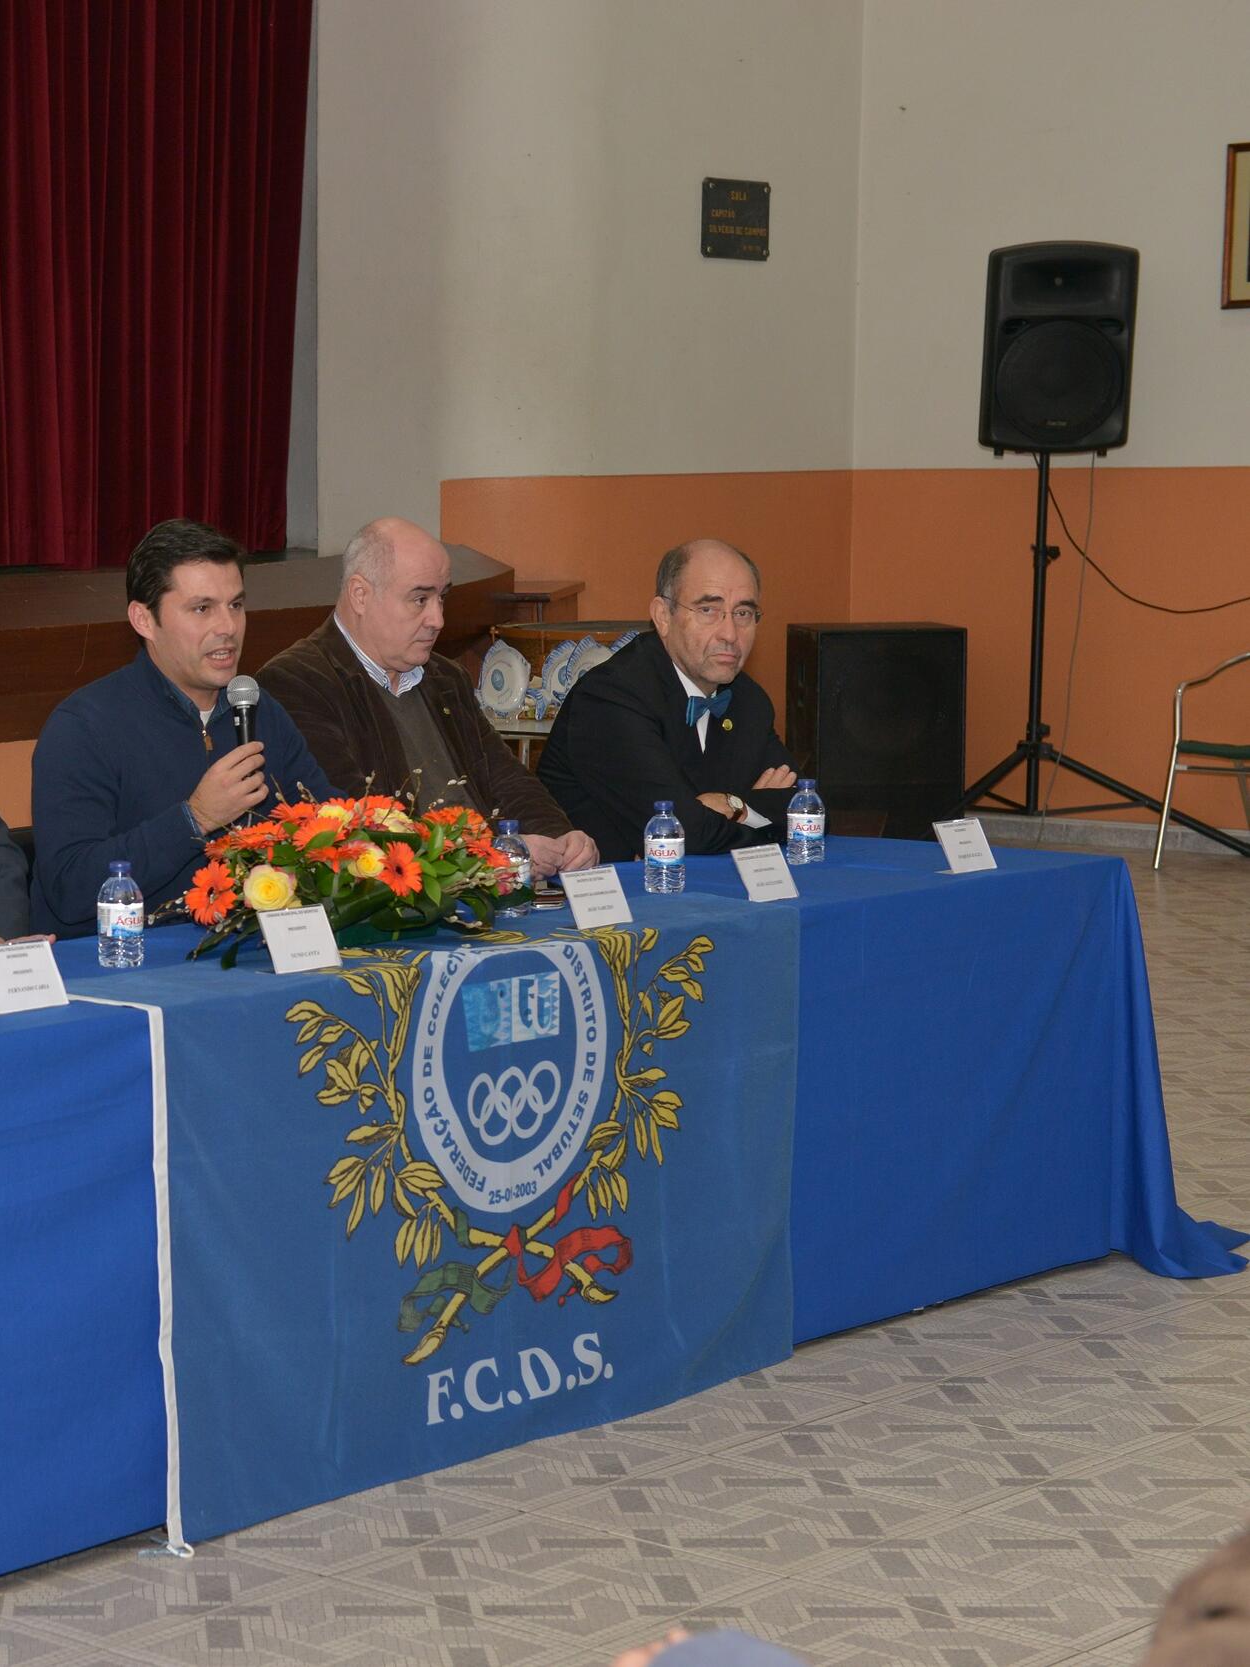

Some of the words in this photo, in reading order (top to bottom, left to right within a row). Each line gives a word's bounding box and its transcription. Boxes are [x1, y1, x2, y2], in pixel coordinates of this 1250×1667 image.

[648, 847, 677, 858] ÁGUA
[795, 822, 822, 832] ÁGUA
[562, 943, 598, 1043] DISTRITO
[423, 1045, 434, 1077] DE
[582, 1051, 597, 1083] DE
[424, 1086, 487, 1193] FEDERAÇÃO
[533, 1089, 590, 1178] SETÚBAL
[426, 1331, 614, 1426] F.C.D.S.
